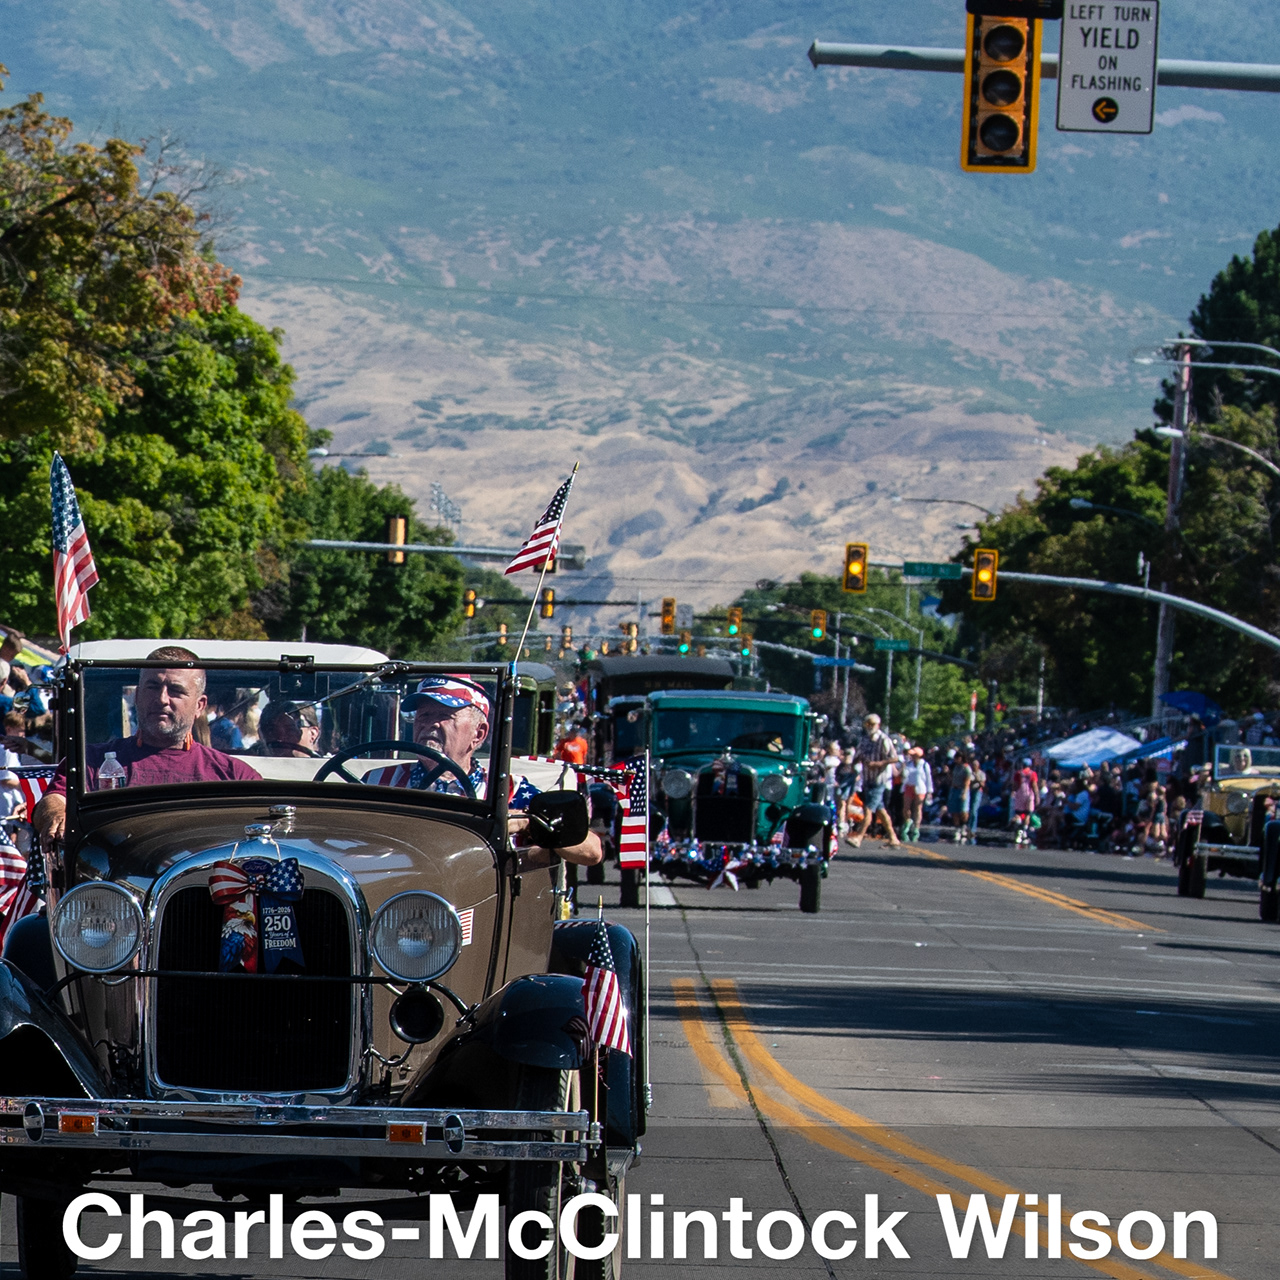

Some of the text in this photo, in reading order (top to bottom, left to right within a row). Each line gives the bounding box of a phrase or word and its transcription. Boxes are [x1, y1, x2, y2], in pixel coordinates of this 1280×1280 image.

[1070, 5, 1151, 21] LEFT TURN
[1080, 26, 1140, 50] YIELD
[1098, 55, 1118, 71] ON
[1071, 74, 1142, 92] FLASHING
[244, 862, 268, 872] Ford
[264, 915, 292, 932] 250
[264, 937, 297, 950] FREEDOM
